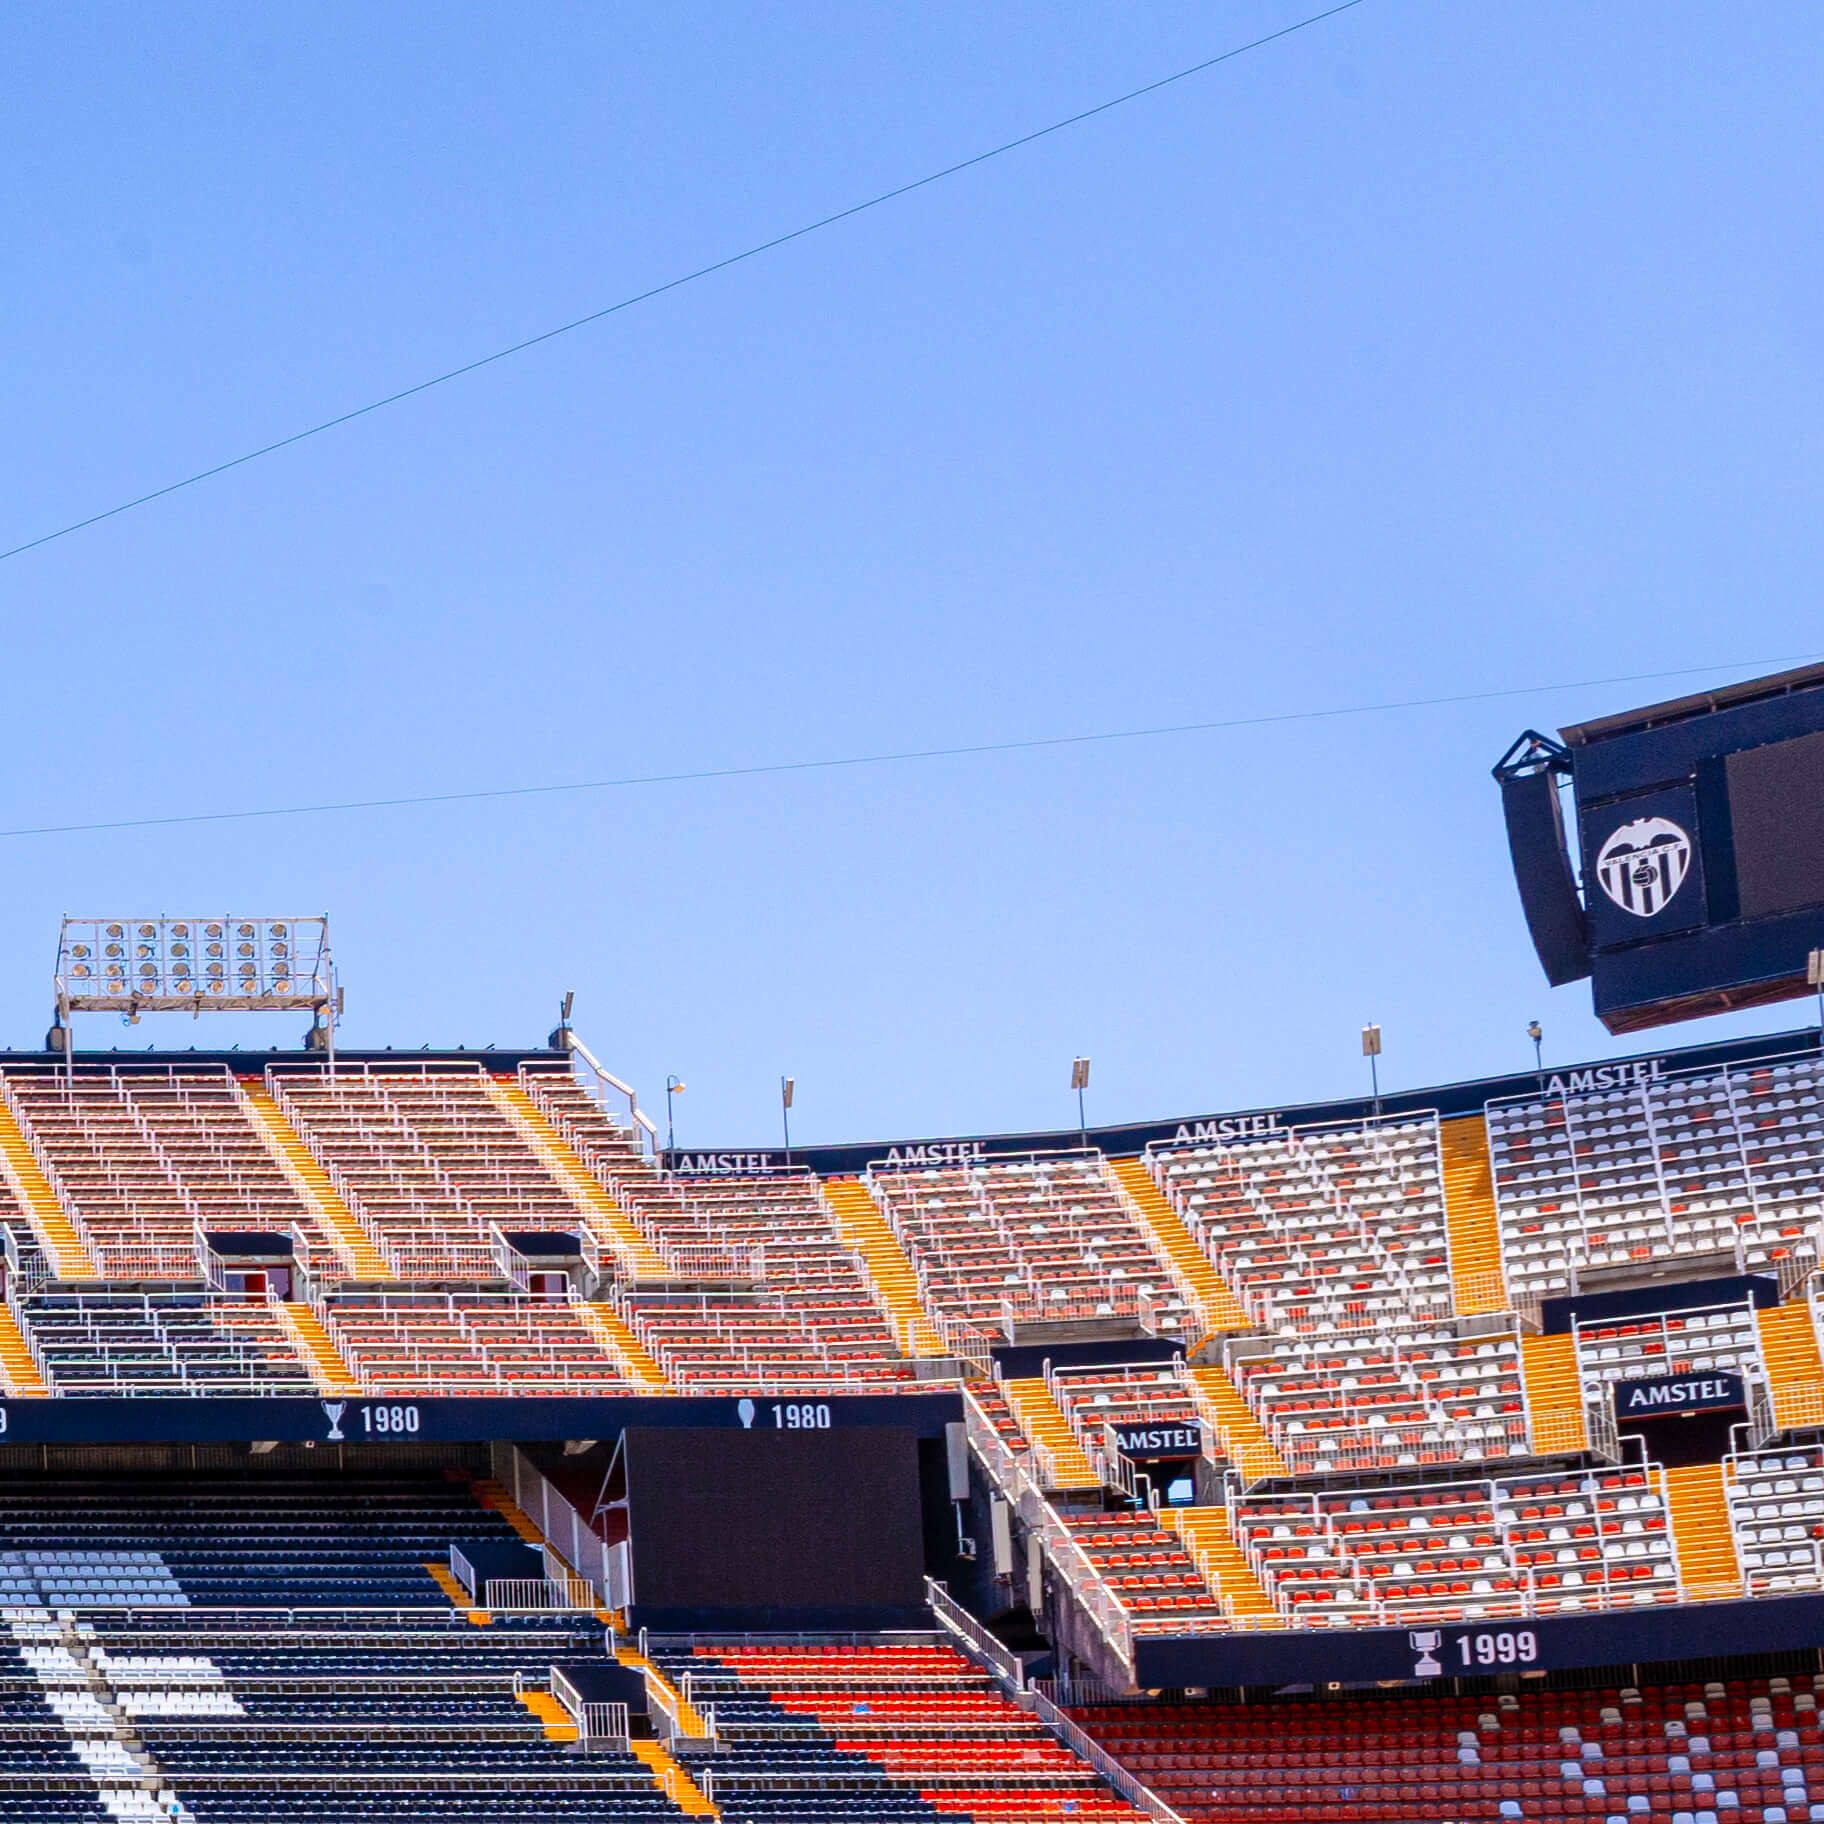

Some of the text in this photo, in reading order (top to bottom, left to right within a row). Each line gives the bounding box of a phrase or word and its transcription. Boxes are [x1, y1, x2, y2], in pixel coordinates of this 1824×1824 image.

[1629, 1379, 1730, 1408] AMSTEL
[361, 1406, 420, 1432] 1980
[772, 1404, 831, 1429] 1980
[1456, 1631, 1538, 1666] 1999
